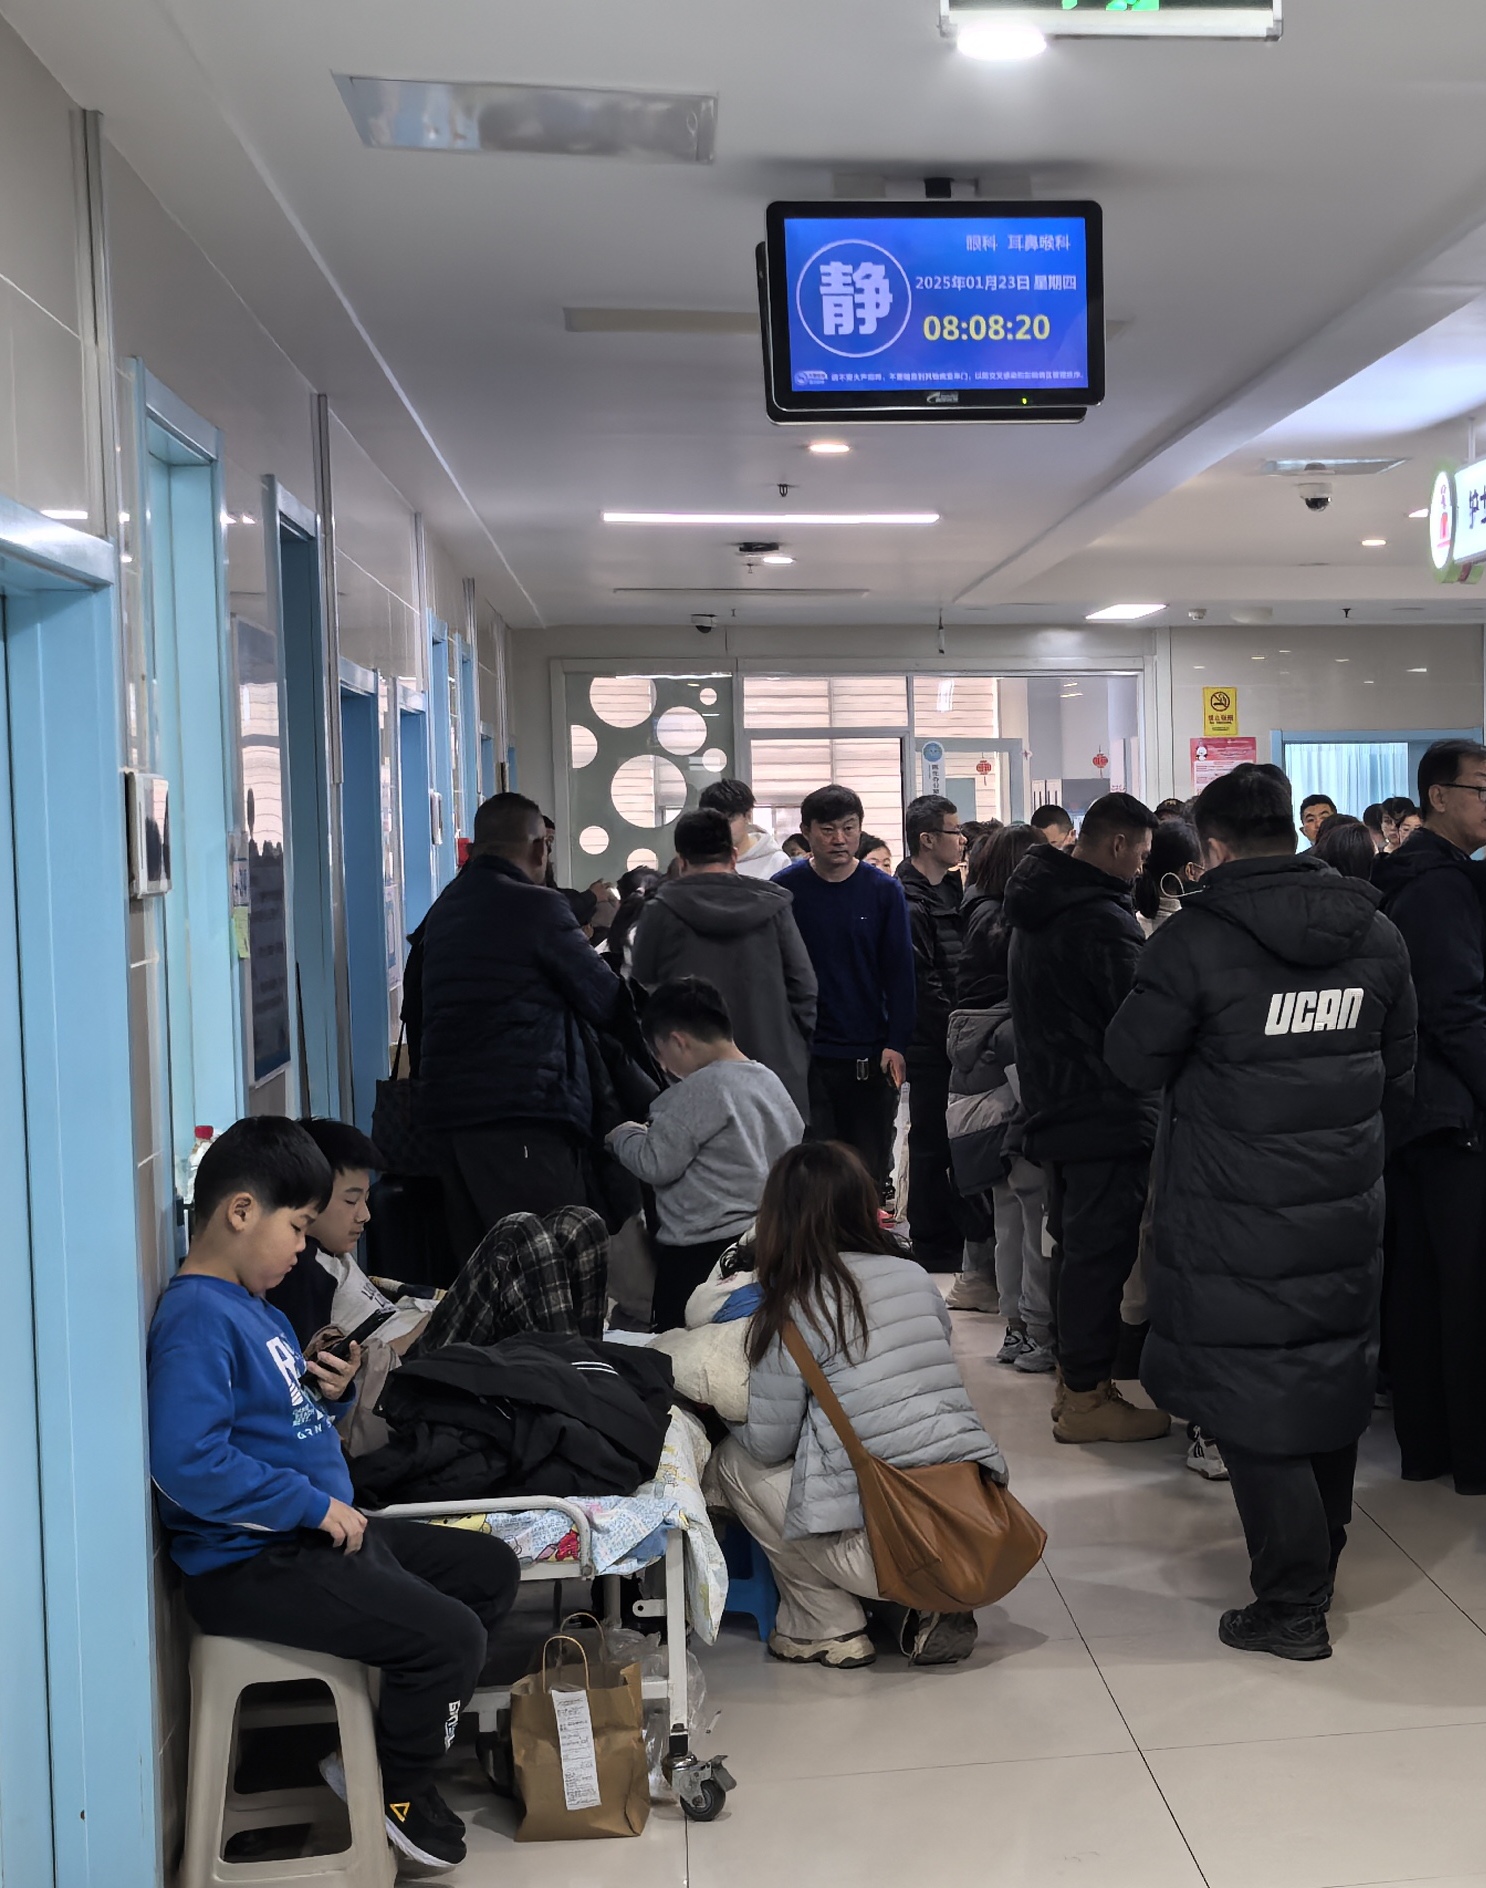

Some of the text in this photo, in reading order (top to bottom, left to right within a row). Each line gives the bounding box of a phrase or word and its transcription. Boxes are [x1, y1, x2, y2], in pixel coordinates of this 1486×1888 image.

[819, 260, 893, 336] 静
[915, 274, 1077, 291] 2025年01月23日 星期四
[923, 315, 1050, 341] 08:08:20
[1264, 987, 1364, 1036] UCAN
